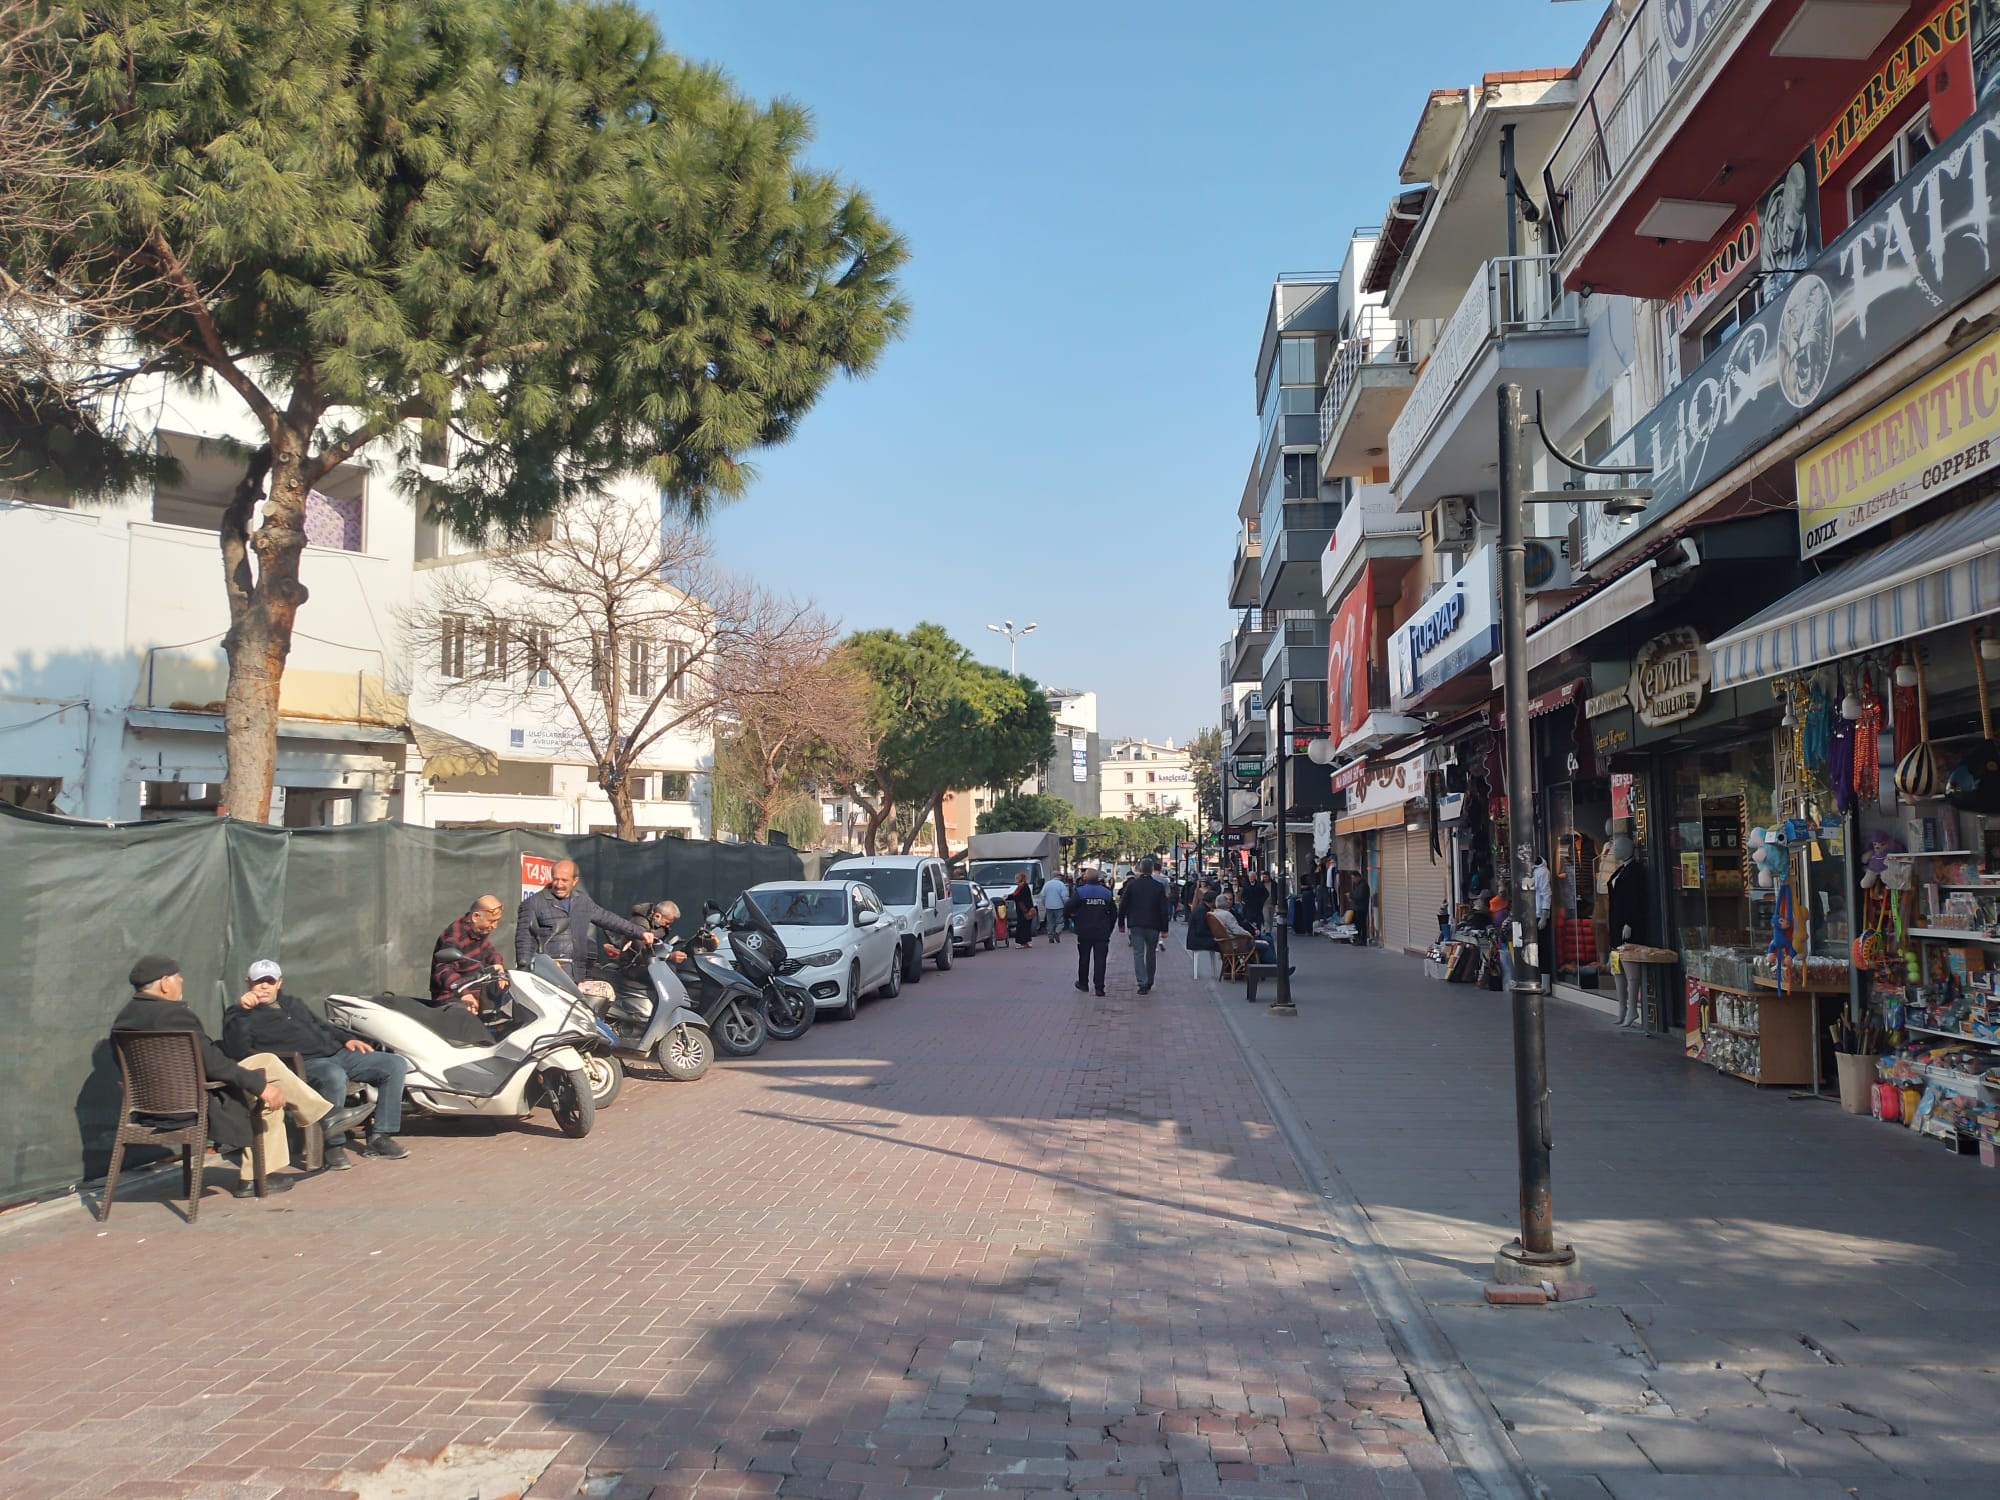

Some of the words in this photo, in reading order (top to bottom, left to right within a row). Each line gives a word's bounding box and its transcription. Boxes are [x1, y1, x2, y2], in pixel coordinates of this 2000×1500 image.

[1818, 2, 1968, 185] PIERCING
[1806, 351, 1999, 516] AUTHENTIC
[1806, 518, 1838, 550] ONIX
[1922, 439, 1991, 490] COPPER
[1410, 592, 1465, 659] TURYAP
[1634, 652, 1691, 713] Kervan
